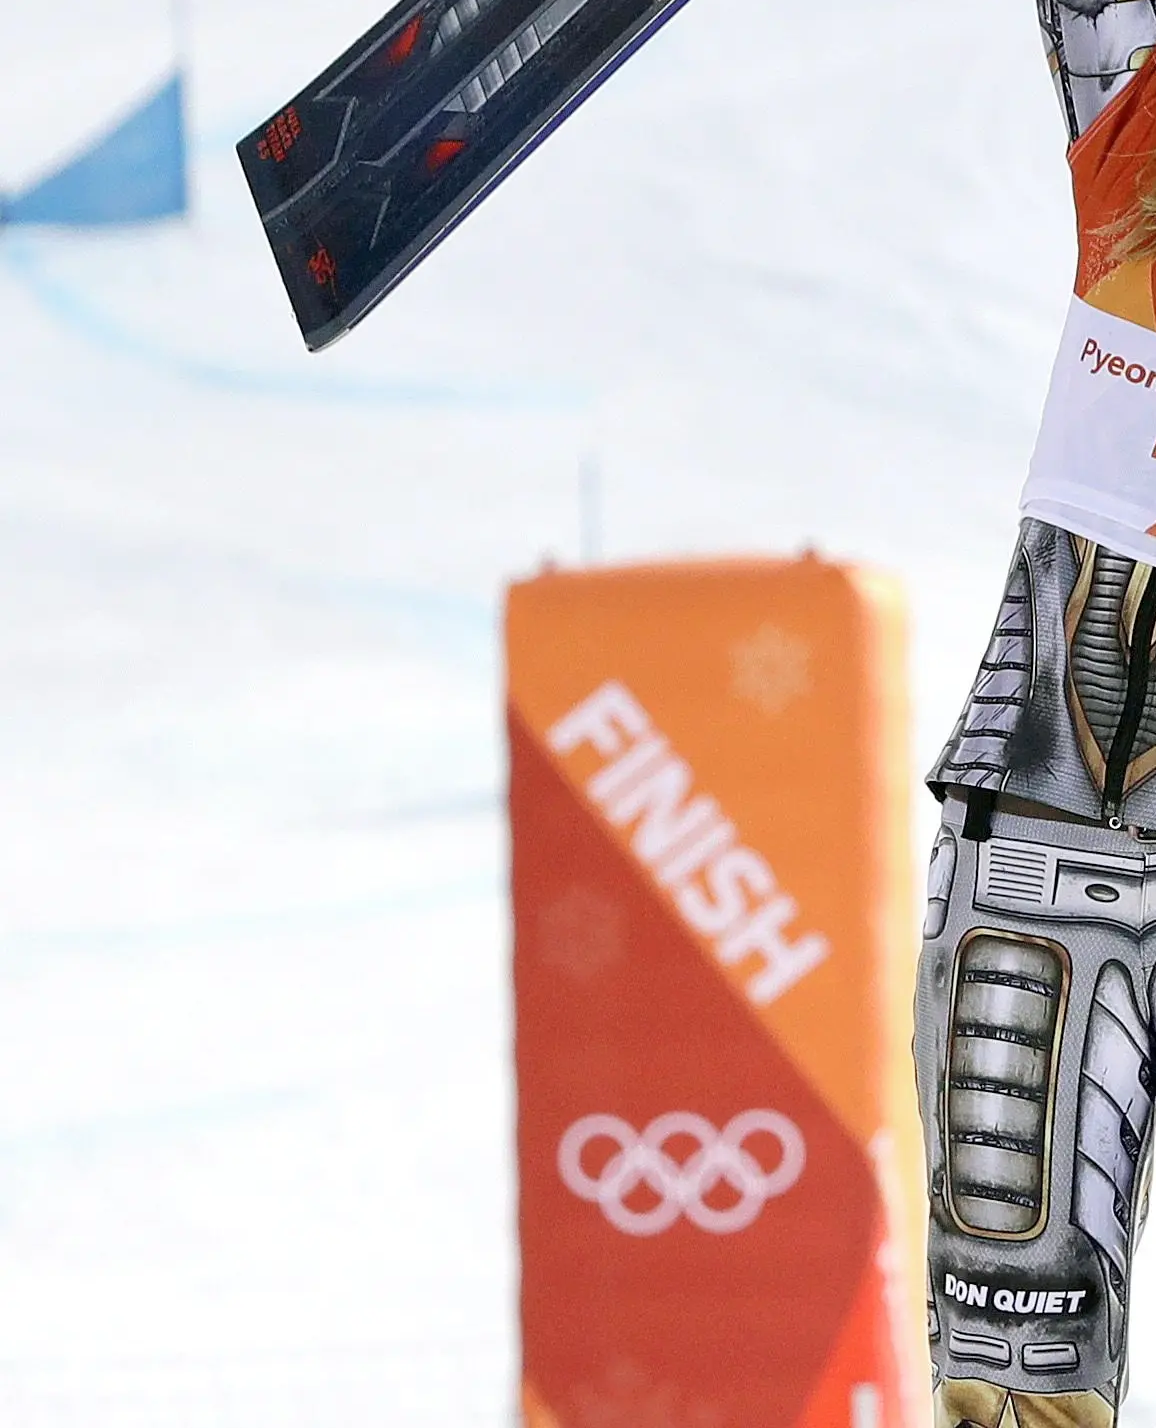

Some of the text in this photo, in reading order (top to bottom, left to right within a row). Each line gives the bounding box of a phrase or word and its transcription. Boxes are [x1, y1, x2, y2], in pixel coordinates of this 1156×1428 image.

[546, 678, 834, 1007] FINISH
[945, 1273, 1087, 1314] DON QUIET
